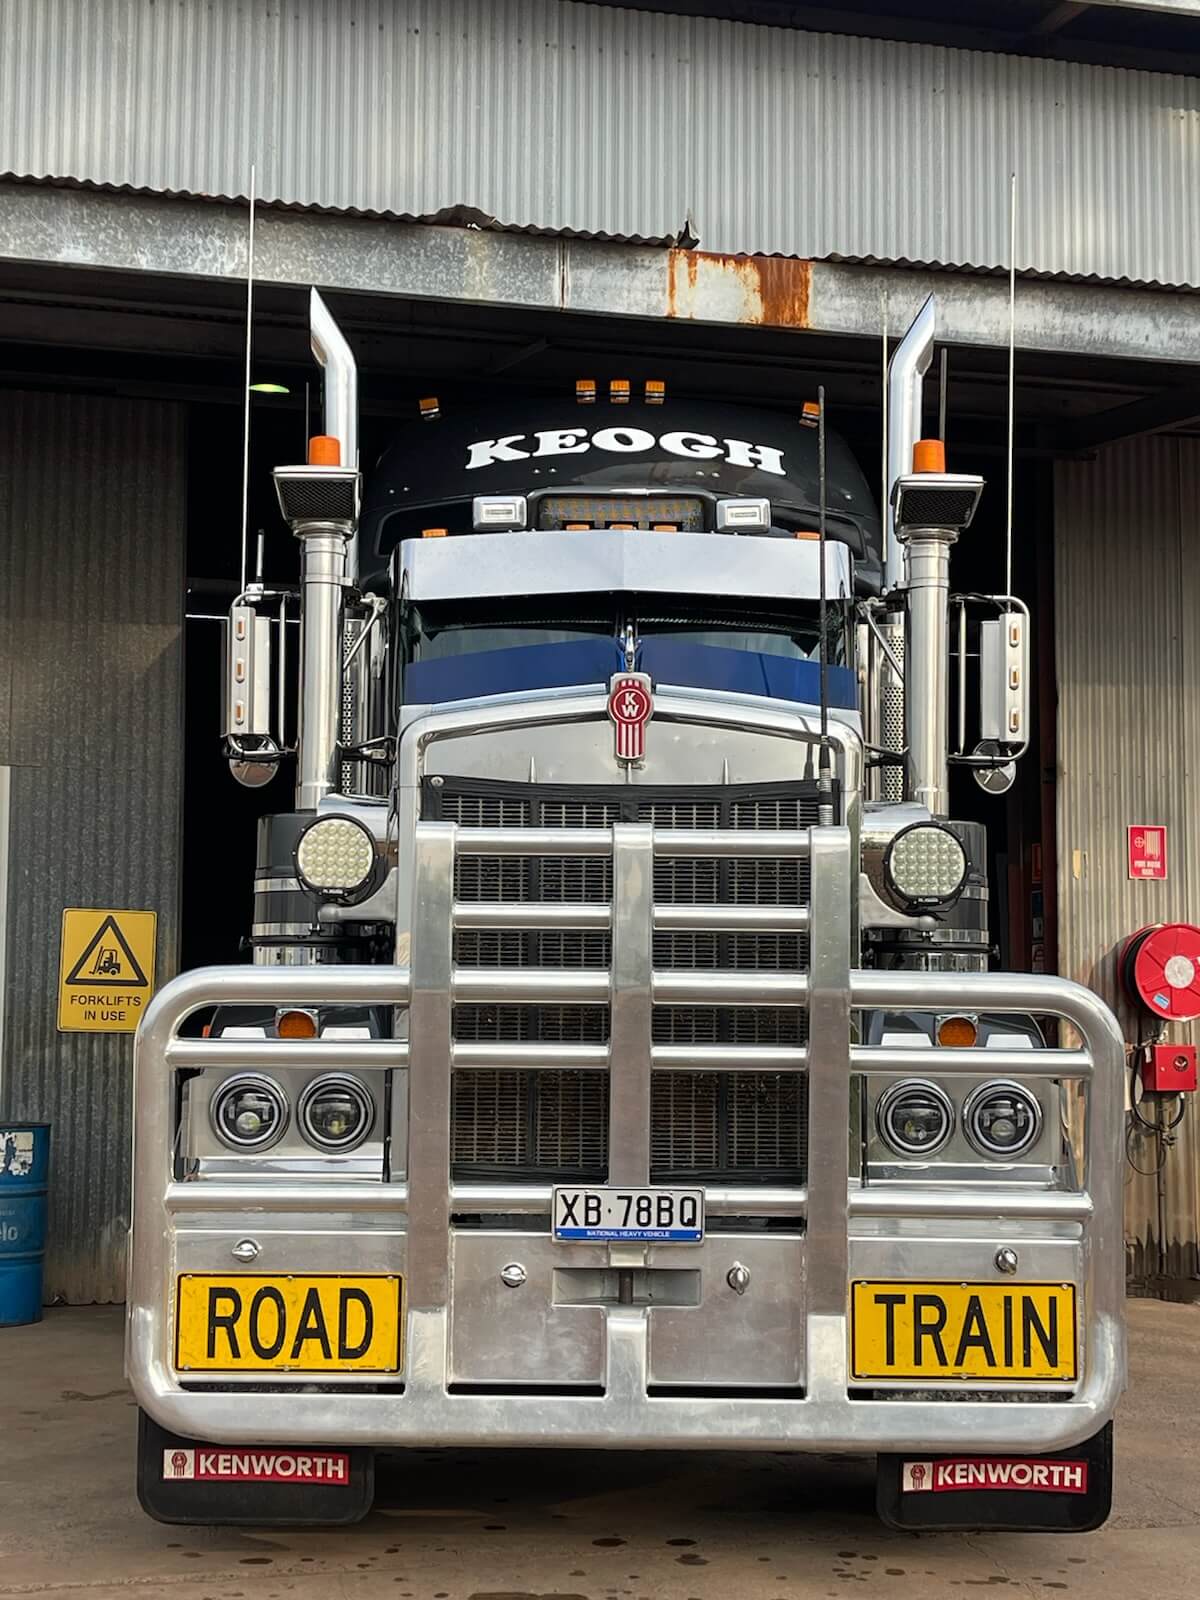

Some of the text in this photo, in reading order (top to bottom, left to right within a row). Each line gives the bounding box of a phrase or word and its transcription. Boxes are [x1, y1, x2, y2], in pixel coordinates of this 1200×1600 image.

[465, 427, 786, 476] KEOGH
[70, 994, 142, 1006] FORKLIFTS
[84, 1010, 127, 1021] IN USE
[0, 1220, 18, 1241] lo
[206, 1286, 374, 1360] ROAD
[874, 1294, 1058, 1368] TRAIN
[199, 1453, 344, 1479] KENWORTH
[938, 1463, 1082, 1488] KENWORTH
